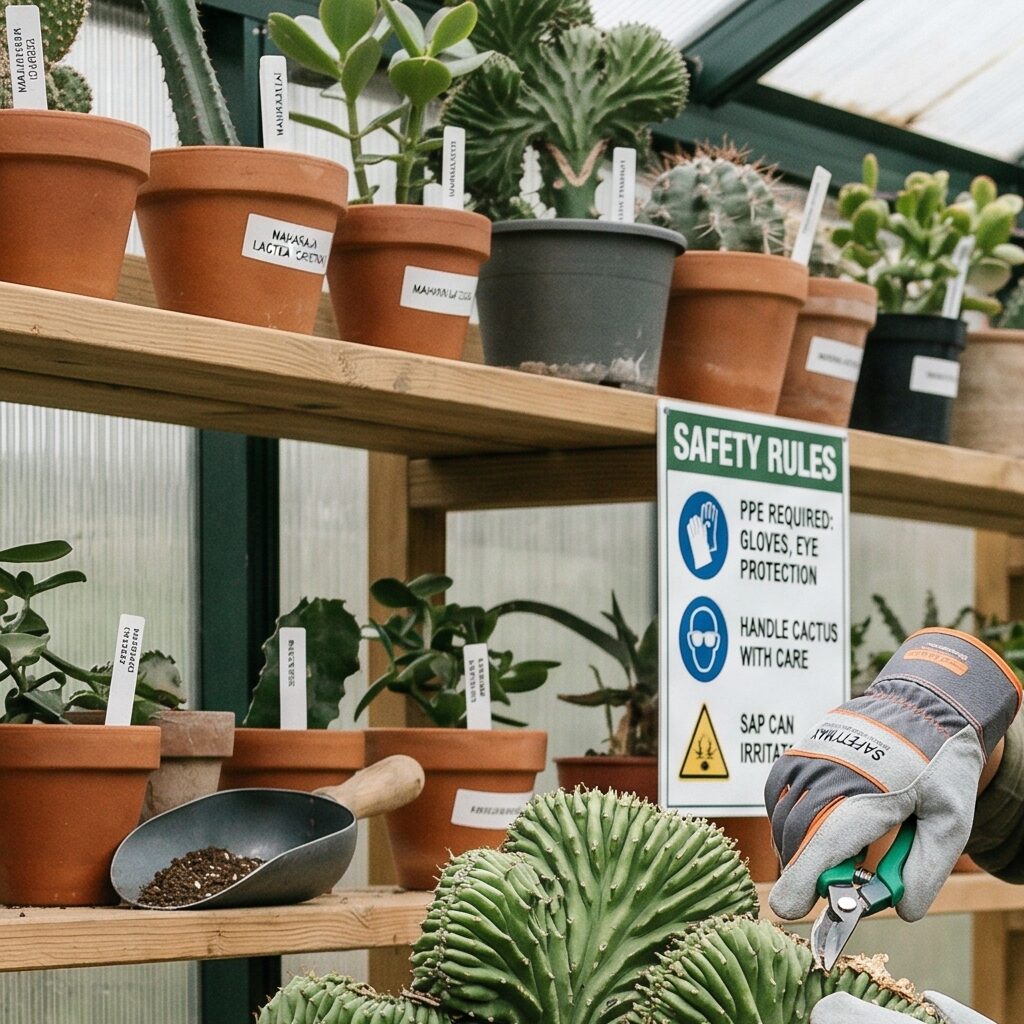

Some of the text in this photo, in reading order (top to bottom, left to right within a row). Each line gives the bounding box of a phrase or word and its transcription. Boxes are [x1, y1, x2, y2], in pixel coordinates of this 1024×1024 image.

[673, 421, 838, 482] SAFETY RULES
[740, 500, 834, 530] PPE REQUIRED:
[740, 529, 819, 558] GLOVES, EYE
[740, 559, 818, 586] PROTECTION
[740, 616, 838, 643] HANDLE CACTUS
[740, 645, 809, 670] WITH CARE
[740, 713, 794, 735] SAP CAN
